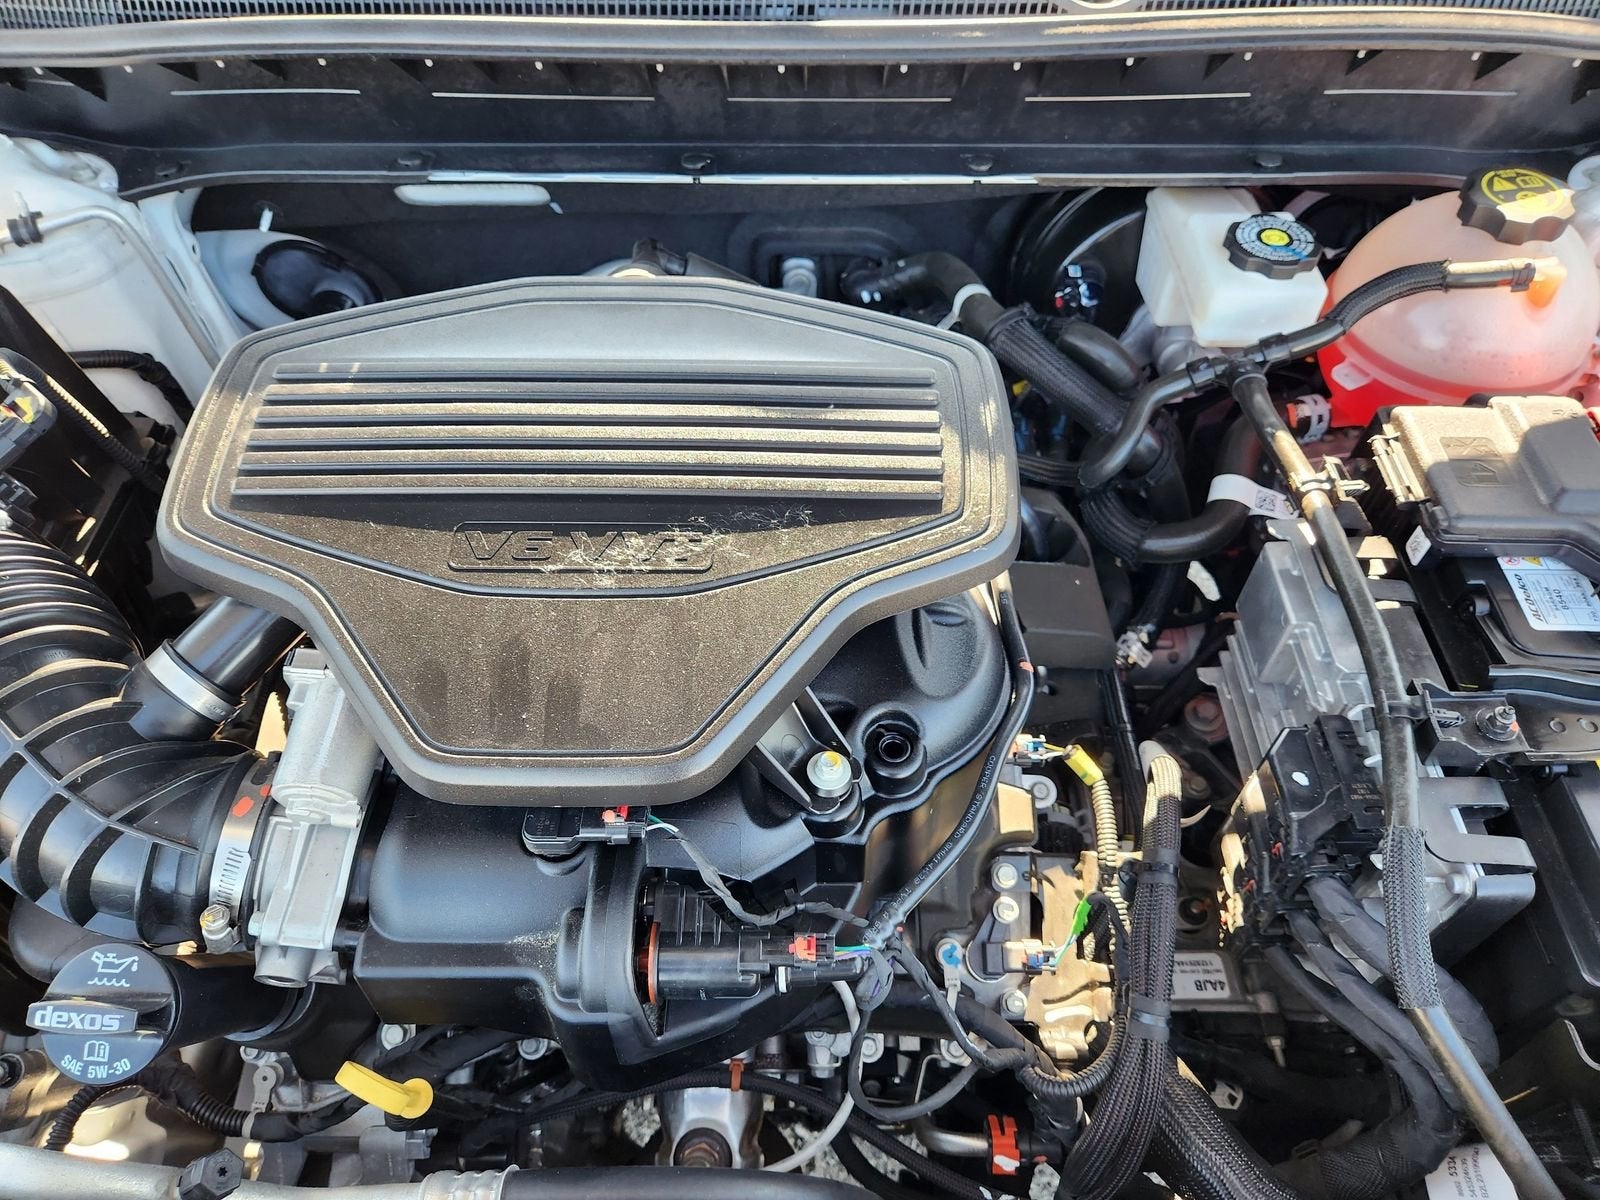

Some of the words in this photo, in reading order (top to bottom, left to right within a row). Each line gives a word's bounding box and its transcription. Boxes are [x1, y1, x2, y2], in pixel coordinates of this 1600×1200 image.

[463, 530, 554, 561] V6
[1514, 573, 1545, 622] ACDelco
[980, 755, 996, 789] COOPER
[954, 794, 983, 839] STANDARD
[890, 887, 911, 909] TYPE
[34, 1005, 120, 1031] dexos
[61, 1054, 85, 1076] SAE
[87, 1058, 131, 1079] 5W-30
[1447, 1155, 1457, 1177] 5334
